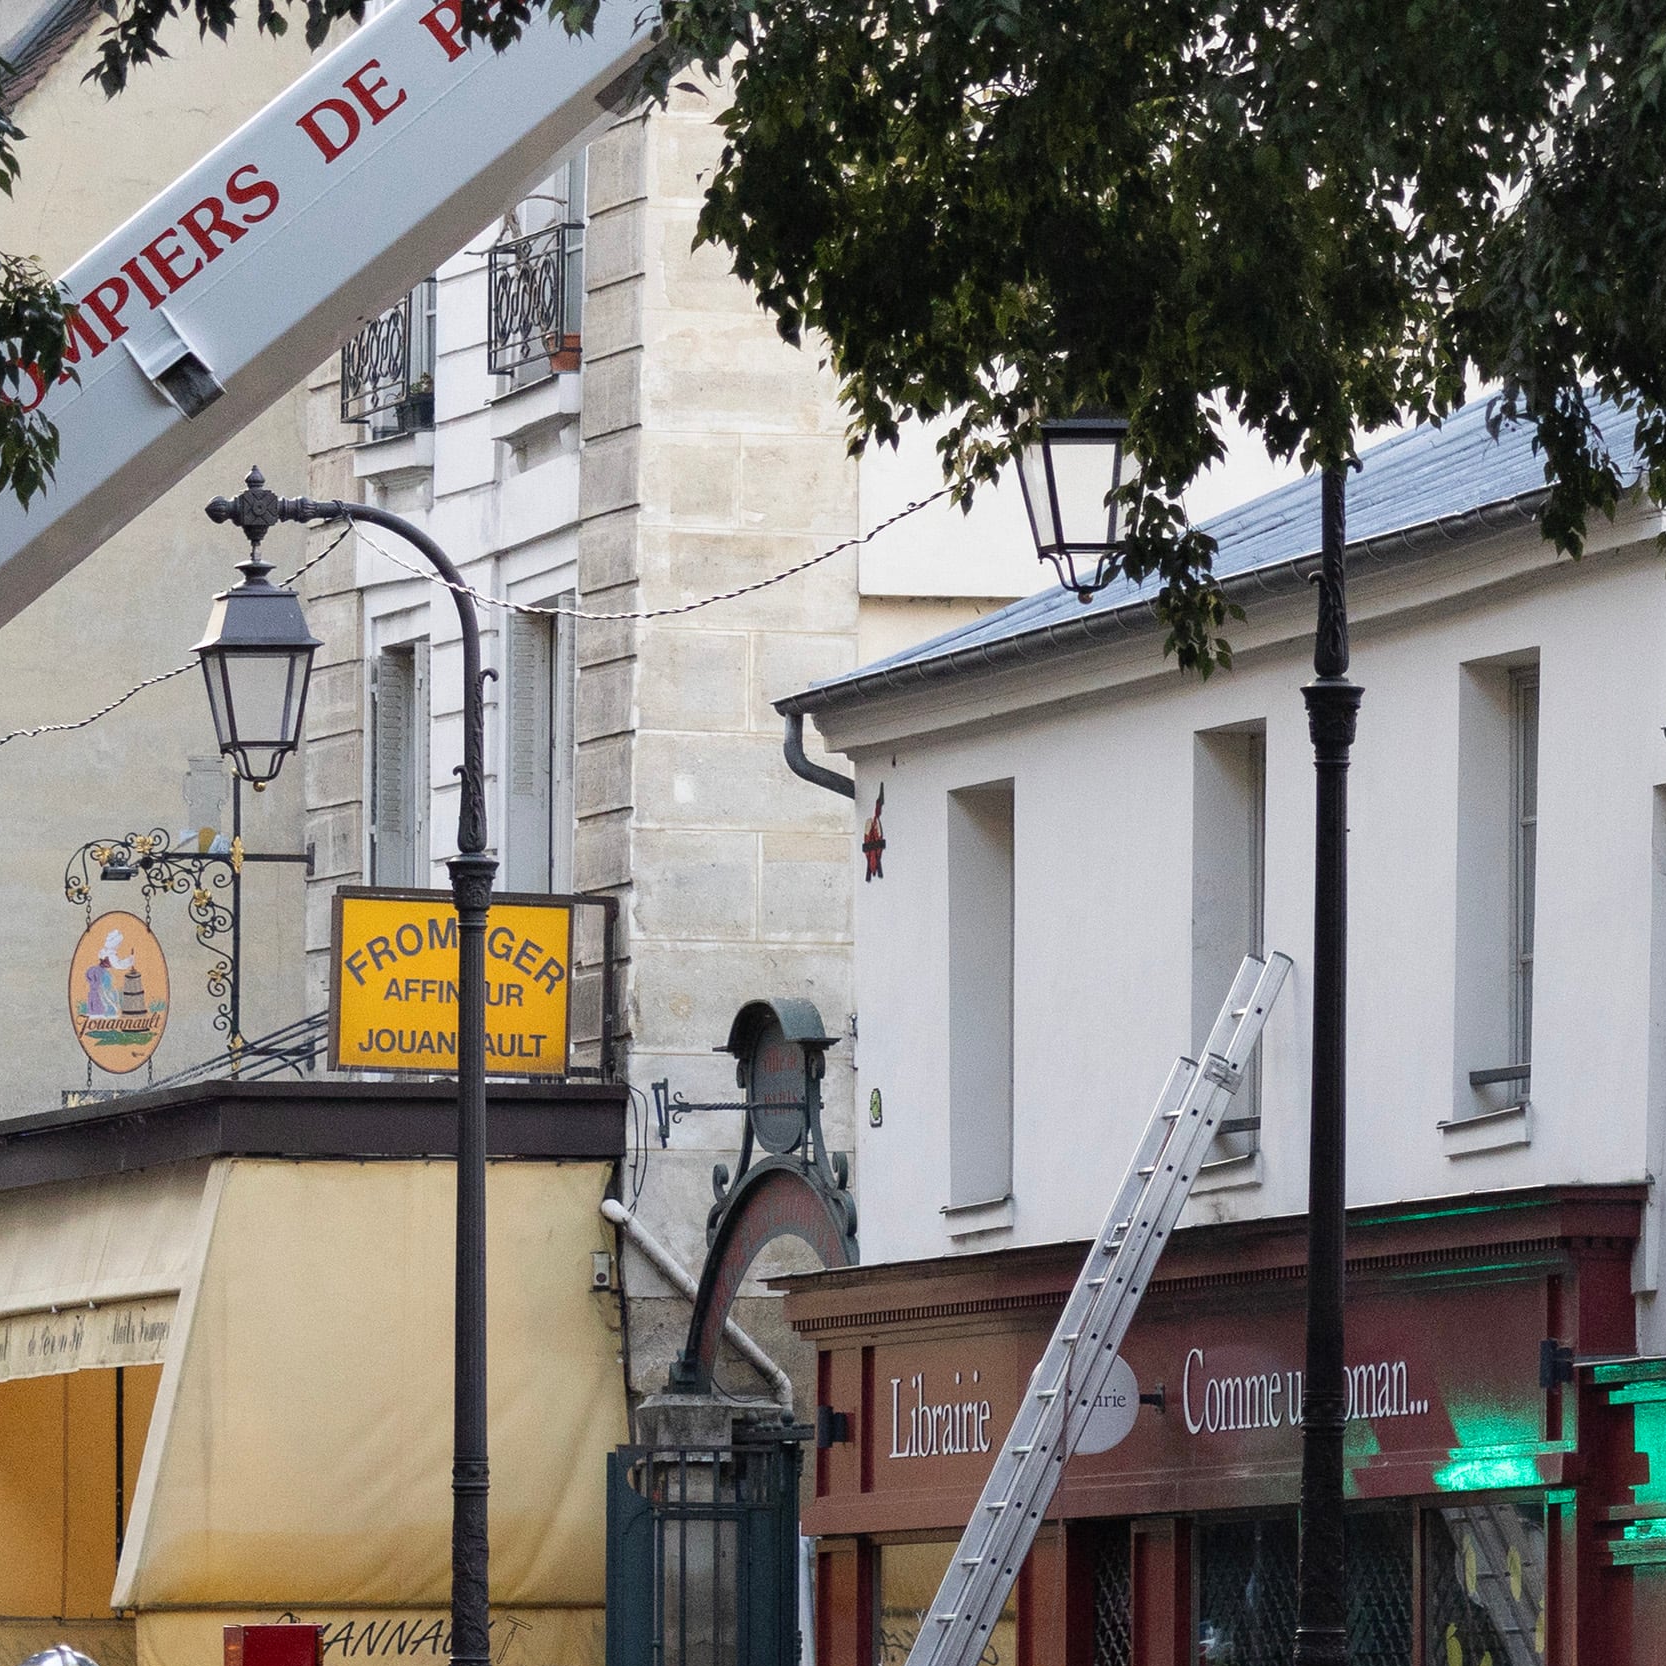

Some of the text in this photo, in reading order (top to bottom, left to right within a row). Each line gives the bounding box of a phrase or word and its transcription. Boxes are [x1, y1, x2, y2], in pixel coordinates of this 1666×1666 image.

[295, 58, 407, 164] DE
[344, 917, 566, 995] FROMGER
[383, 977, 524, 1007] AFFINUR
[358, 1029, 548, 1057] JOUANAULT
[890, 1348, 1429, 1459] Librairie Comme u oman...
